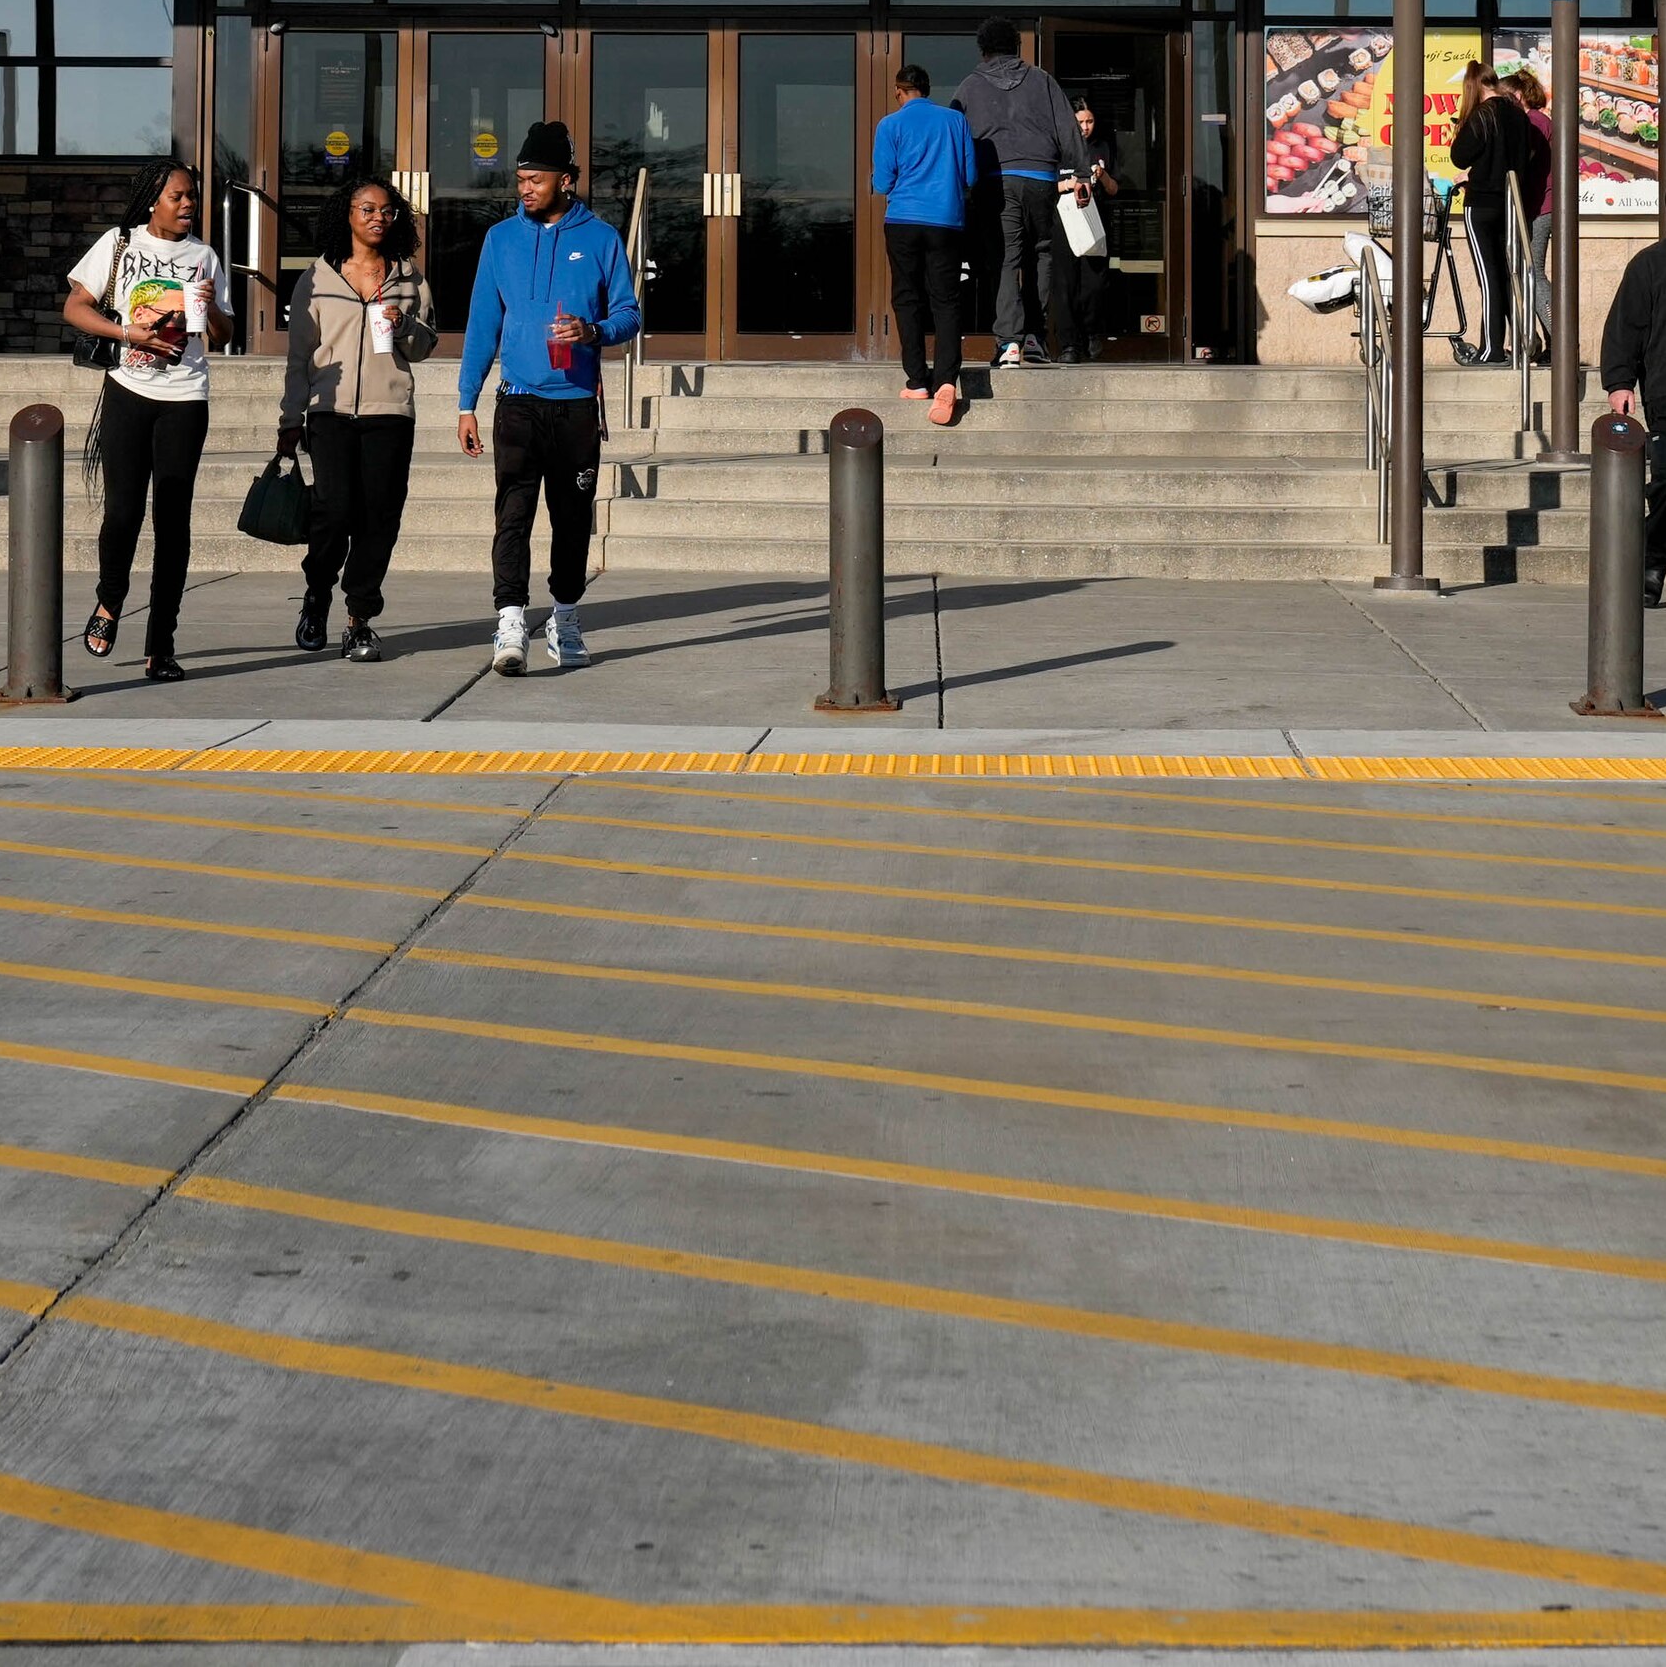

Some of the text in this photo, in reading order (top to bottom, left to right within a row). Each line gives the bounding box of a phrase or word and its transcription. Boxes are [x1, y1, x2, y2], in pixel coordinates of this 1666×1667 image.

[1443, 48, 1476, 62] Sushi
[1430, 153, 1450, 163] Can
[1618, 198, 1633, 207] All
[1635, 198, 1652, 207] You
